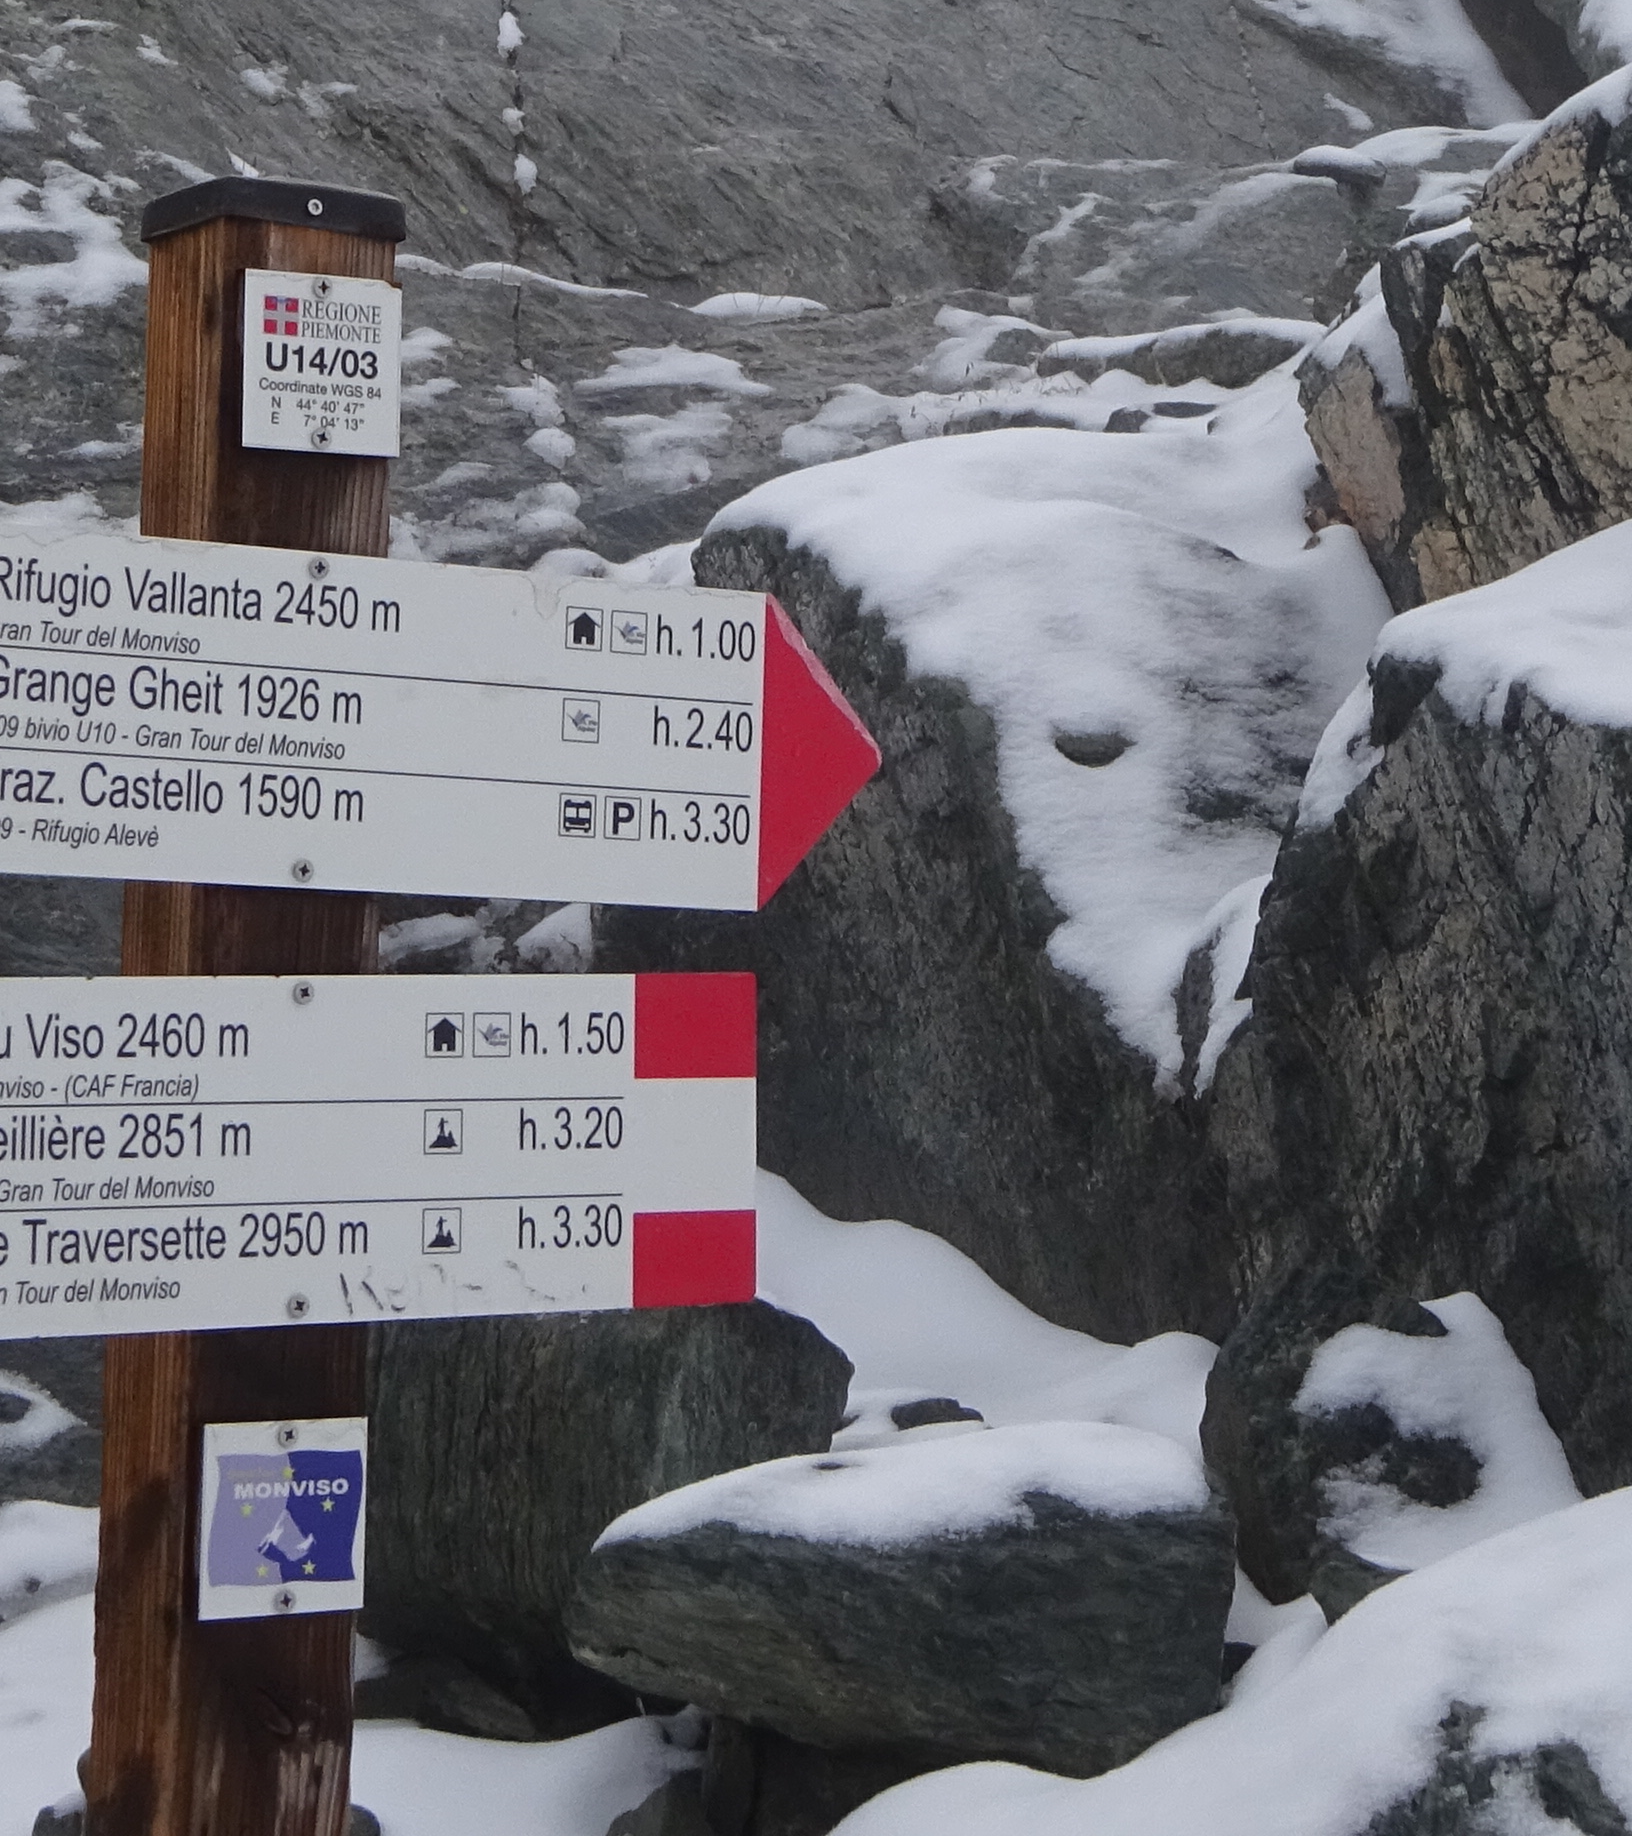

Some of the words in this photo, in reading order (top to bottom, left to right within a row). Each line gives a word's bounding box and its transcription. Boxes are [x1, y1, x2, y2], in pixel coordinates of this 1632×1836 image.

[302, 299, 382, 325] REGIONE
[301, 322, 381, 344] PIEMONTE
[266, 342, 378, 379] U14/03
[258, 377, 328, 395] Coordinate
[330, 384, 363, 398] WGS
[366, 386, 382, 400] 84
[271, 396, 282, 409] N
[271, 411, 280, 425] E
[304, 414, 317, 427] 7°
[124, 566, 262, 622] Vallanta
[273, 580, 359, 630] 2450
[371, 600, 401, 633] m
[40, 620, 83, 645] Tour
[86, 625, 117, 648] del
[120, 627, 201, 655] Monviso
[129, 665, 224, 715] Gheit
[238, 673, 320, 722] 1926
[332, 691, 362, 725] m
[24, 716, 70, 742] bivio
[76, 720, 117, 745] U10
[135, 724, 182, 749] Gran
[190, 727, 232, 752] Tour
[234, 731, 265, 755] del
[268, 733, 346, 761] Monviso
[80, 759, 226, 814] Castello
[239, 772, 322, 821] 1590
[334, 789, 364, 823] m
[31, 818, 100, 850] Rifugio
[103, 823, 159, 848] Alevè
[25, 1012, 104, 1059] Viso
[116, 1012, 205, 1059] 2460
[218, 1023, 249, 1058] m
[64, 1075, 116, 1105] (CAF
[120, 1074, 200, 1103] Francia)
[117, 1112, 203, 1159] 2851
[220, 1122, 251, 1157] m
[52, 1177, 96, 1202] Tour
[99, 1176, 130, 1200] del
[134, 1174, 215, 1199] Monviso
[22, 1216, 227, 1265] Traversette
[238, 1210, 326, 1258] 2950
[338, 1220, 368, 1255] m
[15, 1280, 60, 1305] Tour
[63, 1278, 95, 1303] del
[99, 1276, 181, 1302] Monviso
[234, 1478, 349, 1500] MONVISO
